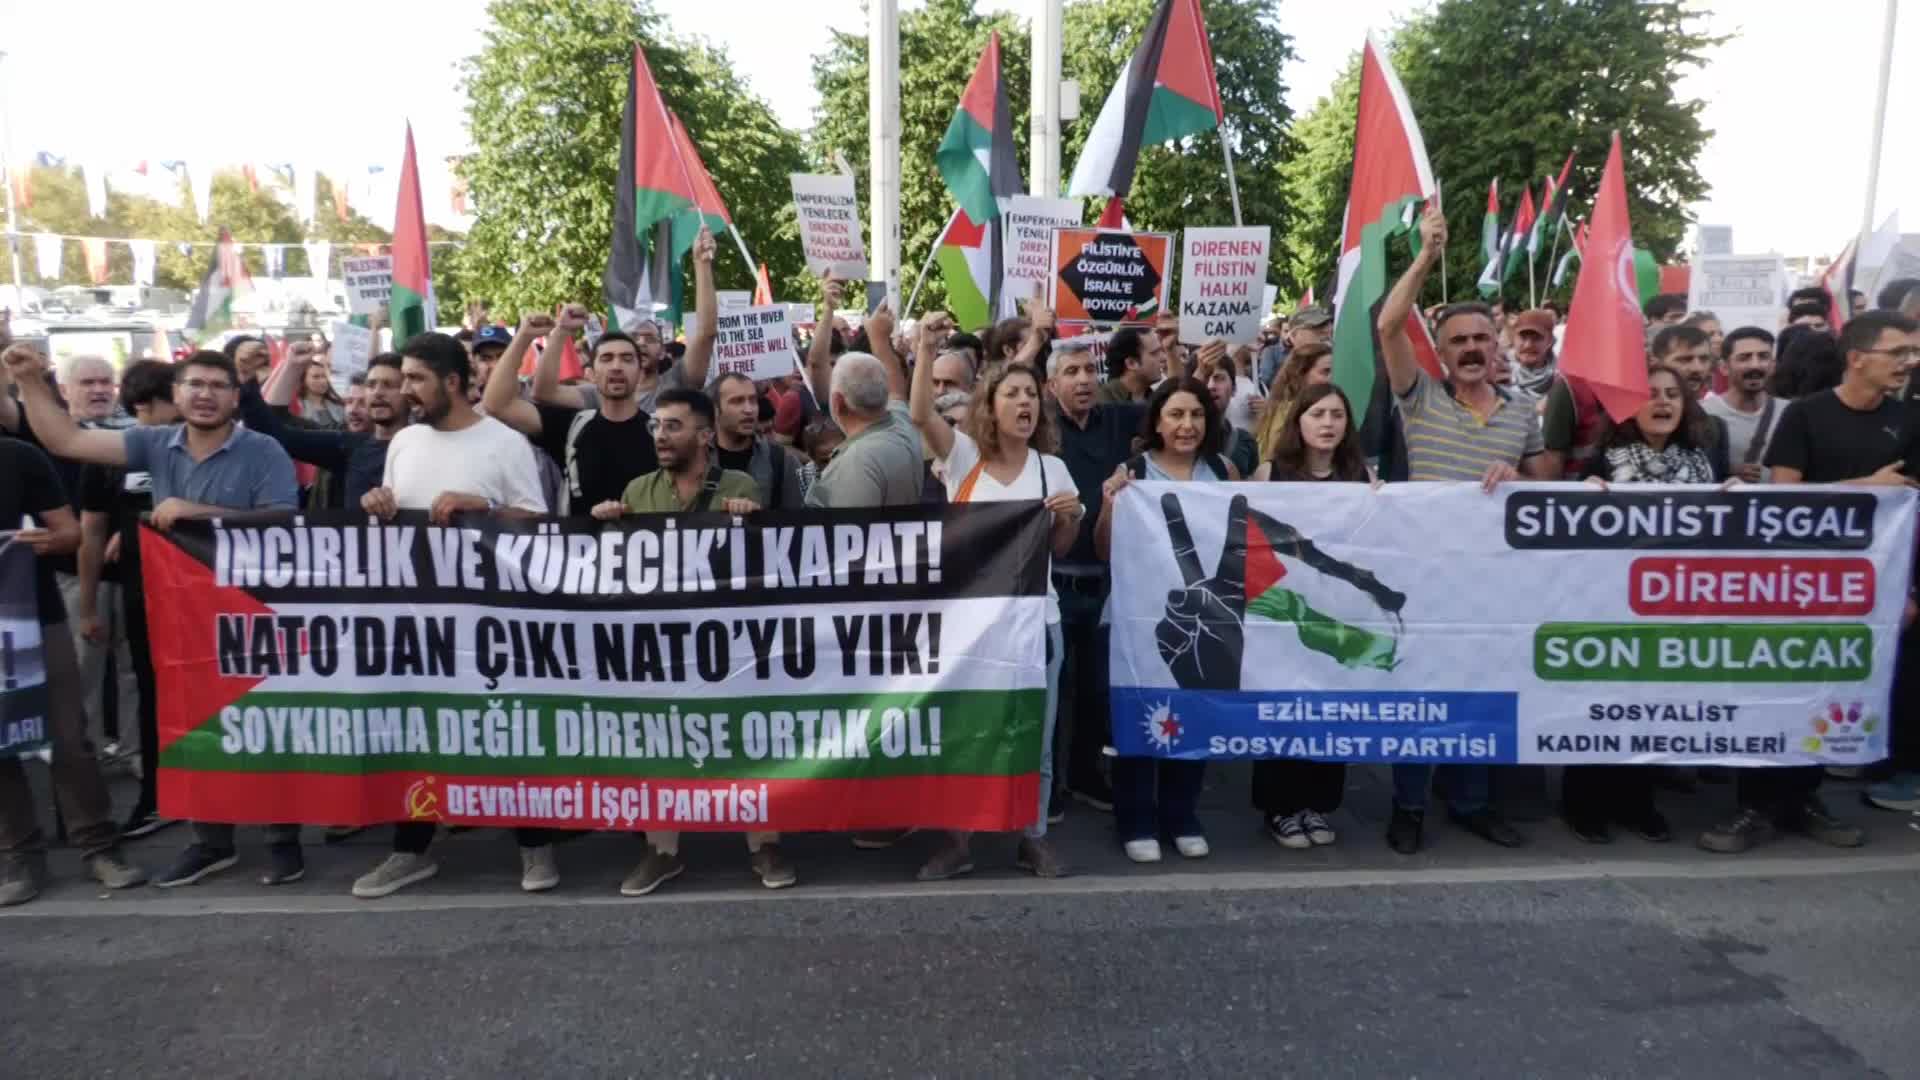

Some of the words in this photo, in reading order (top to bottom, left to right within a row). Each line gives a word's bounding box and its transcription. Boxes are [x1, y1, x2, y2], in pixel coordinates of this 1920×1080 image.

[1077, 258, 1145, 276] ÖZGÜRLÜK
[1200, 281, 1248, 297] HALKI
[1082, 299, 1134, 311] BOYKOT
[743, 312, 759, 327] THE
[760, 310, 784, 325] RIVER
[1204, 321, 1236, 336] CAK
[729, 329, 746, 342] THE
[748, 327, 764, 340] SEA
[717, 342, 766, 358] PALESTINE
[767, 337, 788, 352] WILL
[733, 360, 756, 373] FREE
[1515, 498, 1733, 538] SİYONİST
[1746, 498, 1866, 543] İŞGAL
[211, 515, 418, 588] İNCİRLİK
[426, 526, 486, 591] VE
[495, 515, 748, 595] KÜRECİK'İ
[761, 520, 943, 590] KAPAT!
[1640, 564, 1866, 609] DİRENİŞLE
[215, 613, 456, 677] NATO'DAN
[474, 615, 581, 690] ÇIK!
[593, 616, 817, 682] NATO'YU
[832, 612, 943, 677] YIK!
[1543, 636, 1641, 669] SON
[1658, 637, 1865, 669] BULACAK
[1257, 697, 1449, 722] EZİLENLERİN
[1588, 700, 1740, 722] SOSYALİST
[219, 705, 432, 756] SOYKIRIMA
[436, 698, 546, 758] DEĞİL
[555, 701, 733, 769] DİRENİŞE
[741, 708, 871, 760] ORTAK
[880, 707, 943, 758] OL!
[1208, 732, 1372, 757] SOSYALİST
[1380, 733, 1497, 758] PARTİSİ
[1536, 734, 1621, 752] KADIN
[1629, 731, 1787, 754] MECLİSLERİ
[446, 780, 584, 819] DEVRİMCİ
[591, 781, 650, 826] İŞÇİ
[657, 783, 769, 823] PARTİSİ
